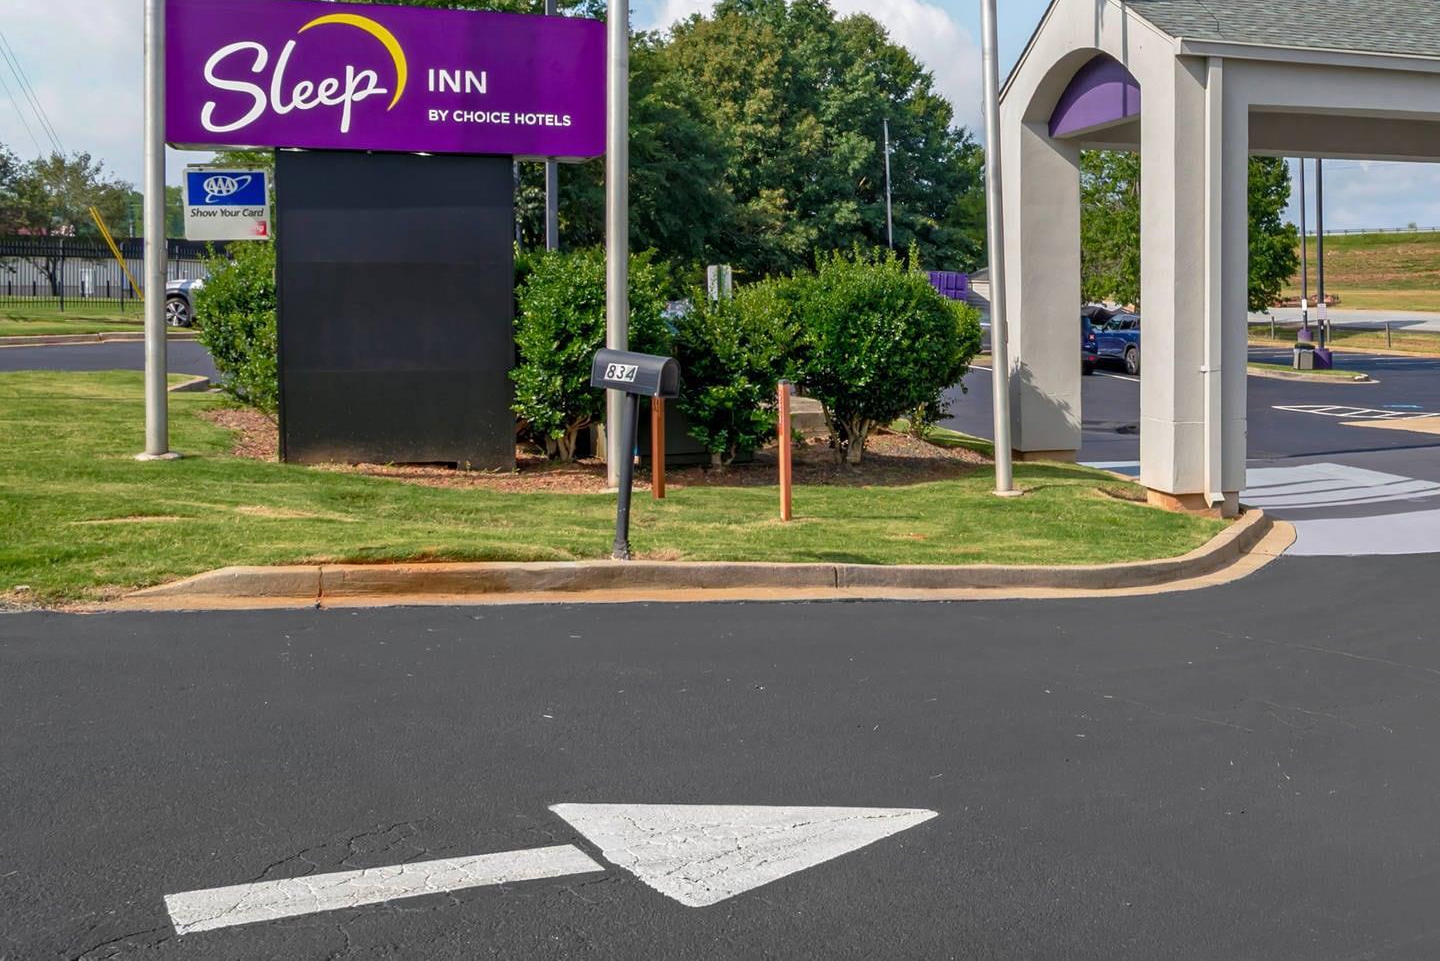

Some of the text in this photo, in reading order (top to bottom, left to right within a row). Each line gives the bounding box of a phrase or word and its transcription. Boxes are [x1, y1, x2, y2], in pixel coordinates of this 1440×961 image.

[200, 39, 387, 133] Sleep
[428, 68, 487, 94] INN
[428, 109, 572, 127] BY CHOICE HOTELS
[208, 177, 234, 195] AAA
[190, 208, 264, 218] Show Your Card
[606, 364, 637, 381] 834
